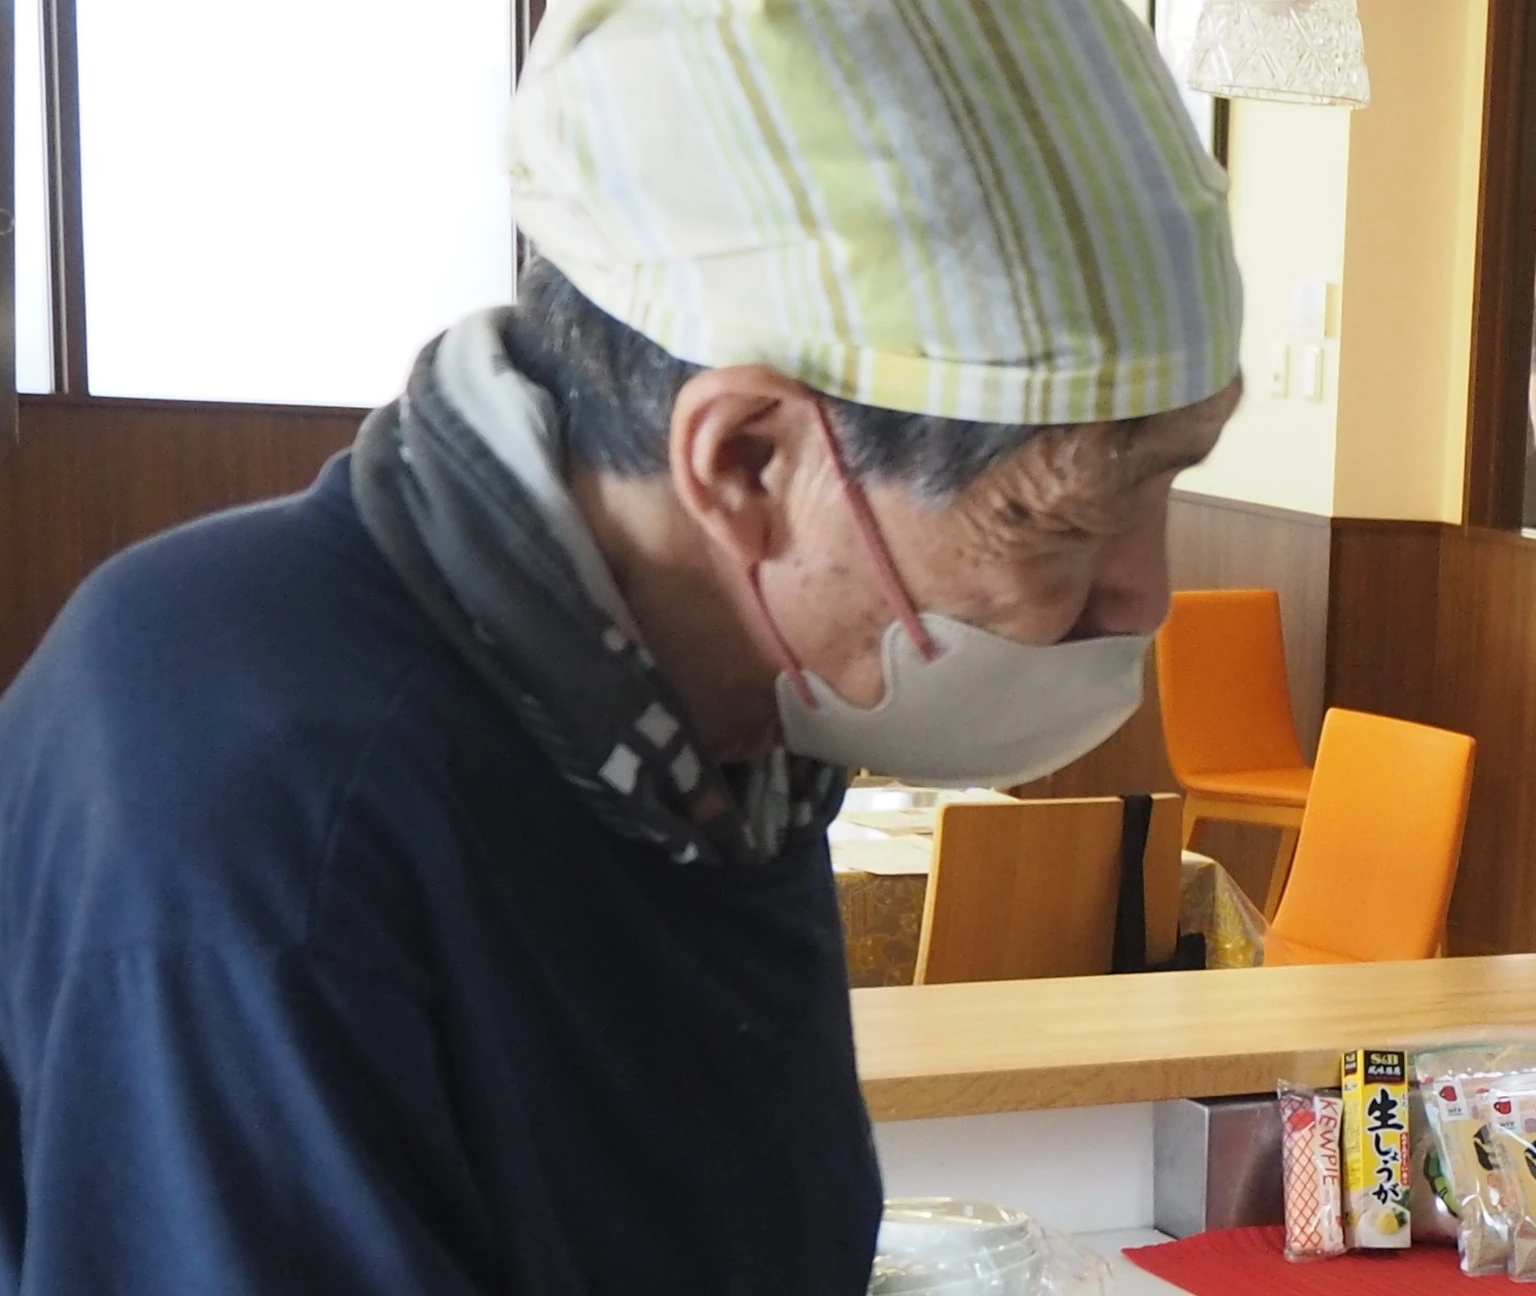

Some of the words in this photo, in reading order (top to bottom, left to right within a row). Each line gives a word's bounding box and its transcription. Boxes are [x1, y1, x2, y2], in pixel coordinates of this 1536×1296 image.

[1371, 1053, 1399, 1066] S&B
[1318, 1100, 1339, 1186] KEWPIE
[1366, 1088, 1405, 1205] 生しょうが
